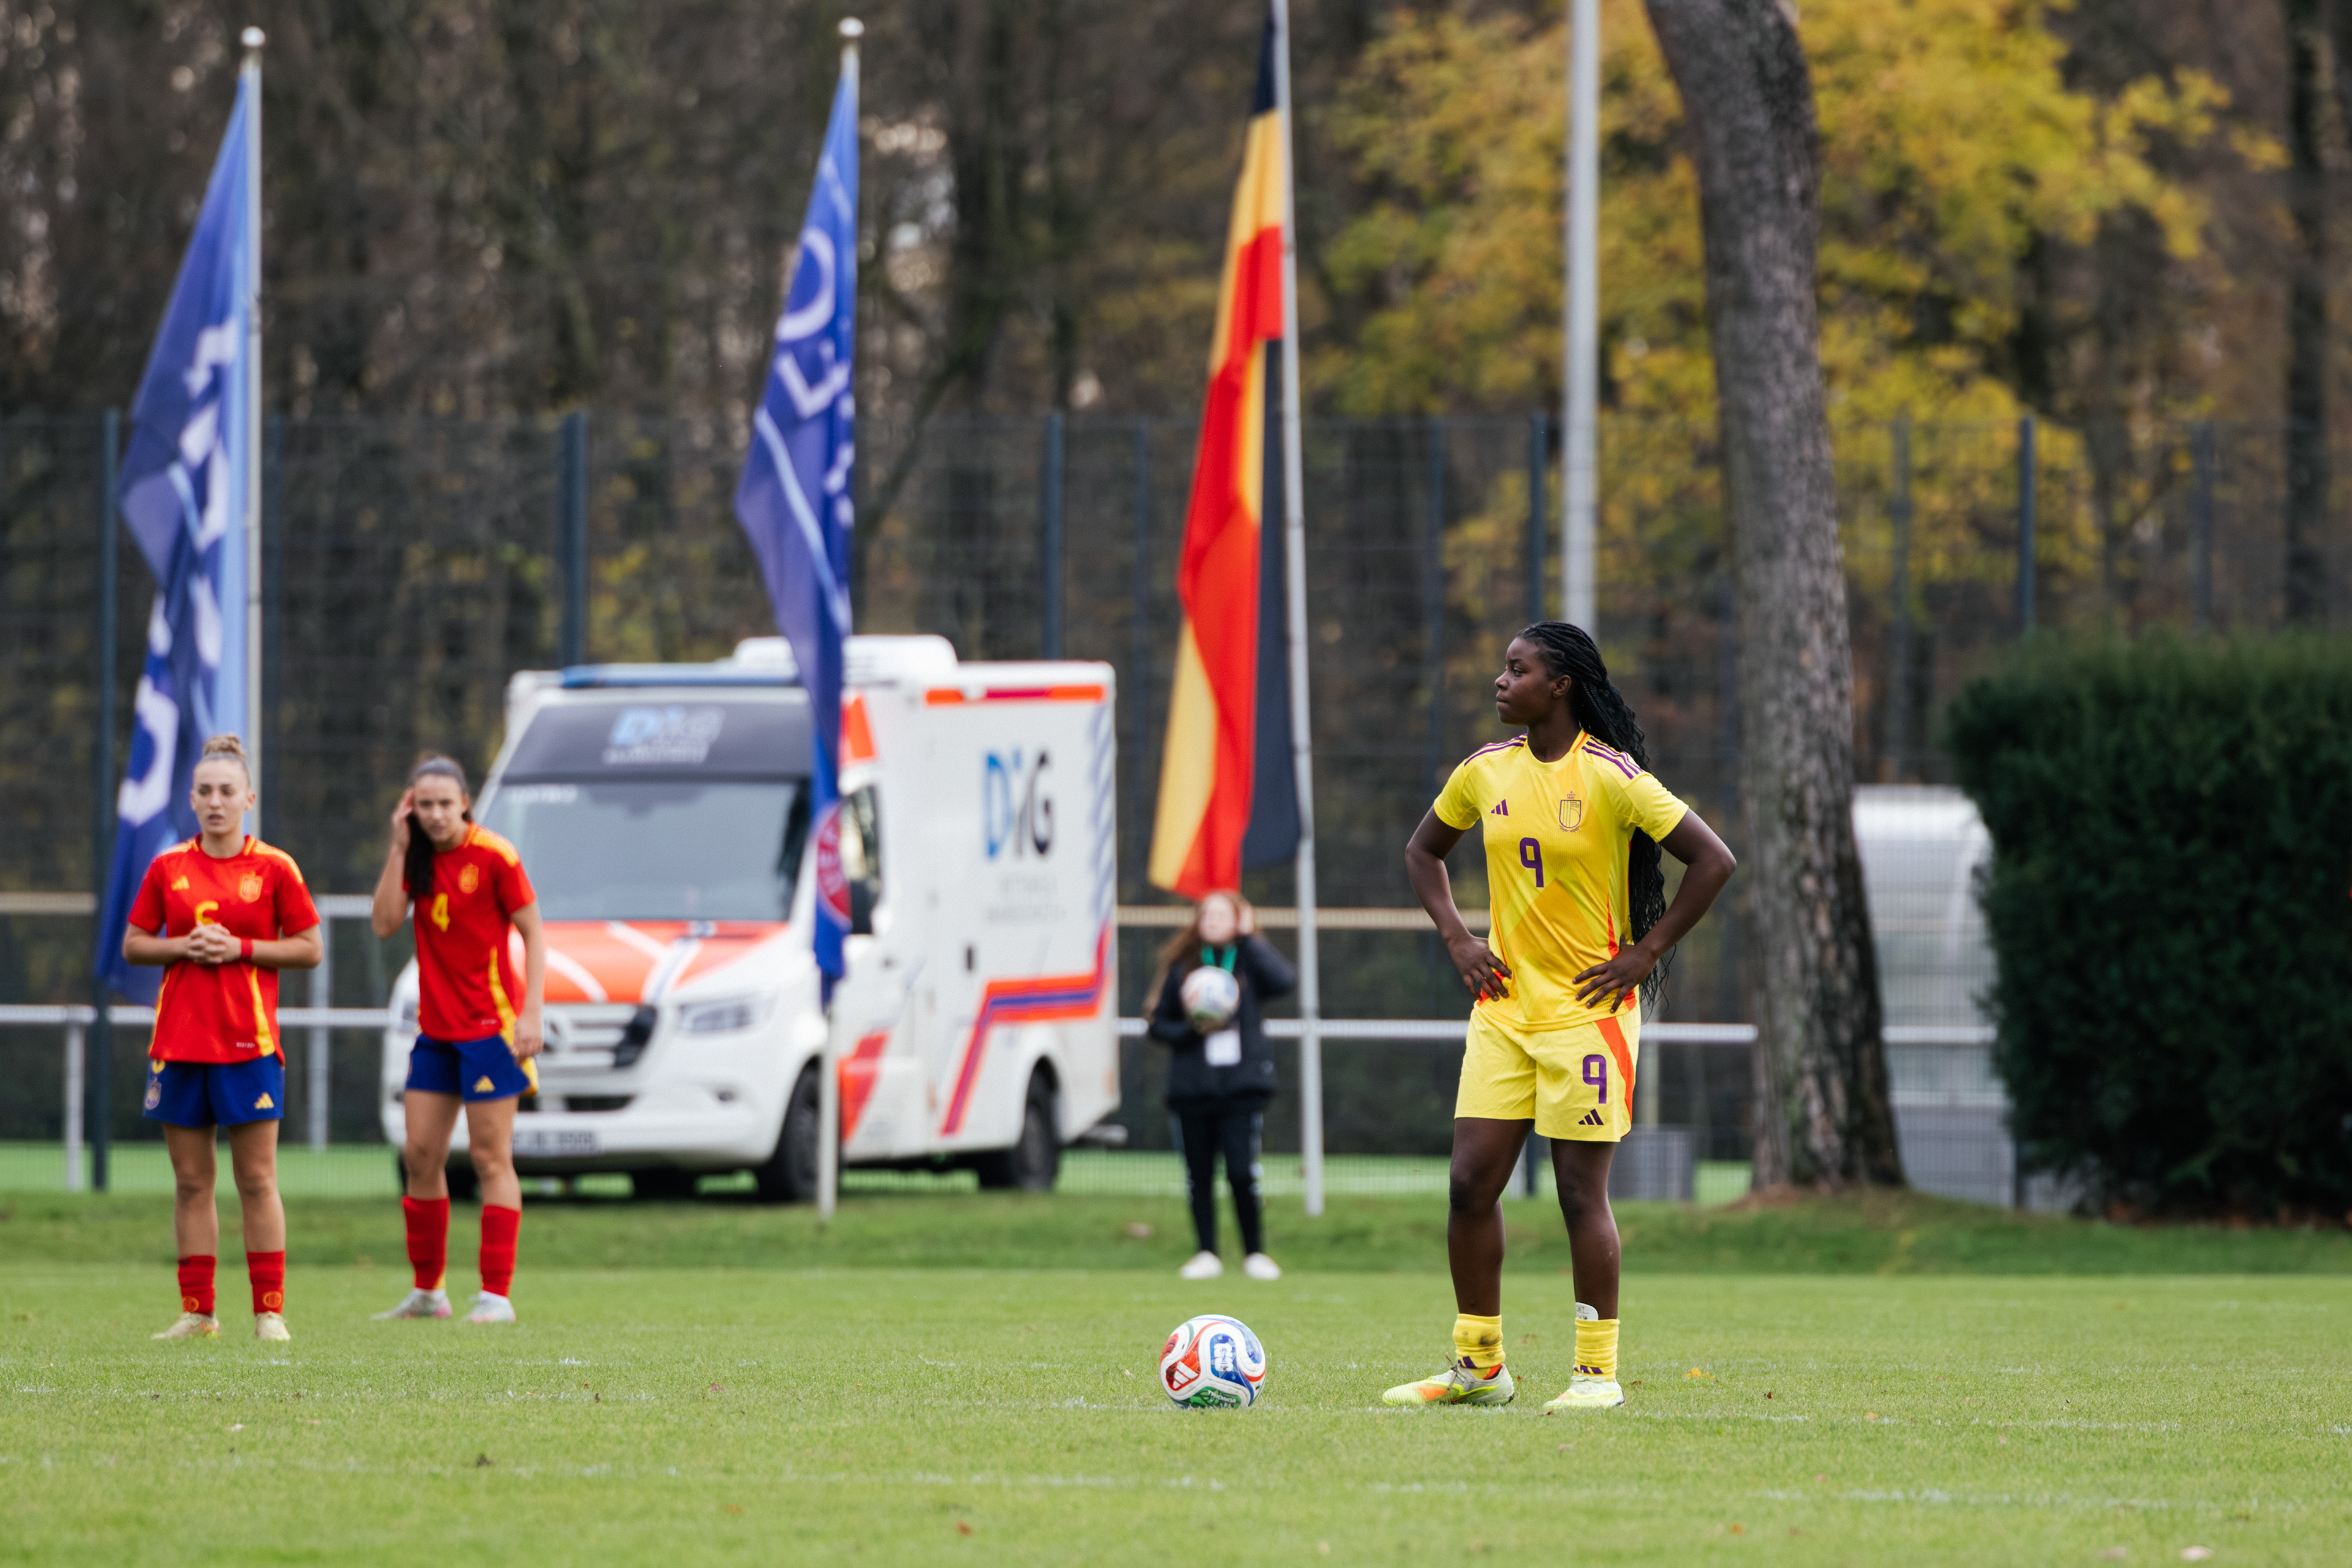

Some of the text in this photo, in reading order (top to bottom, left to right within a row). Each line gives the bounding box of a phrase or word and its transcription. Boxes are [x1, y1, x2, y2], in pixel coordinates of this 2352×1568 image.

[1520, 837, 1544, 888] 9
[431, 892, 450, 932] 4
[1583, 1054, 1607, 1104] 9
[1207, 1389, 1236, 1403] TRIONDA
